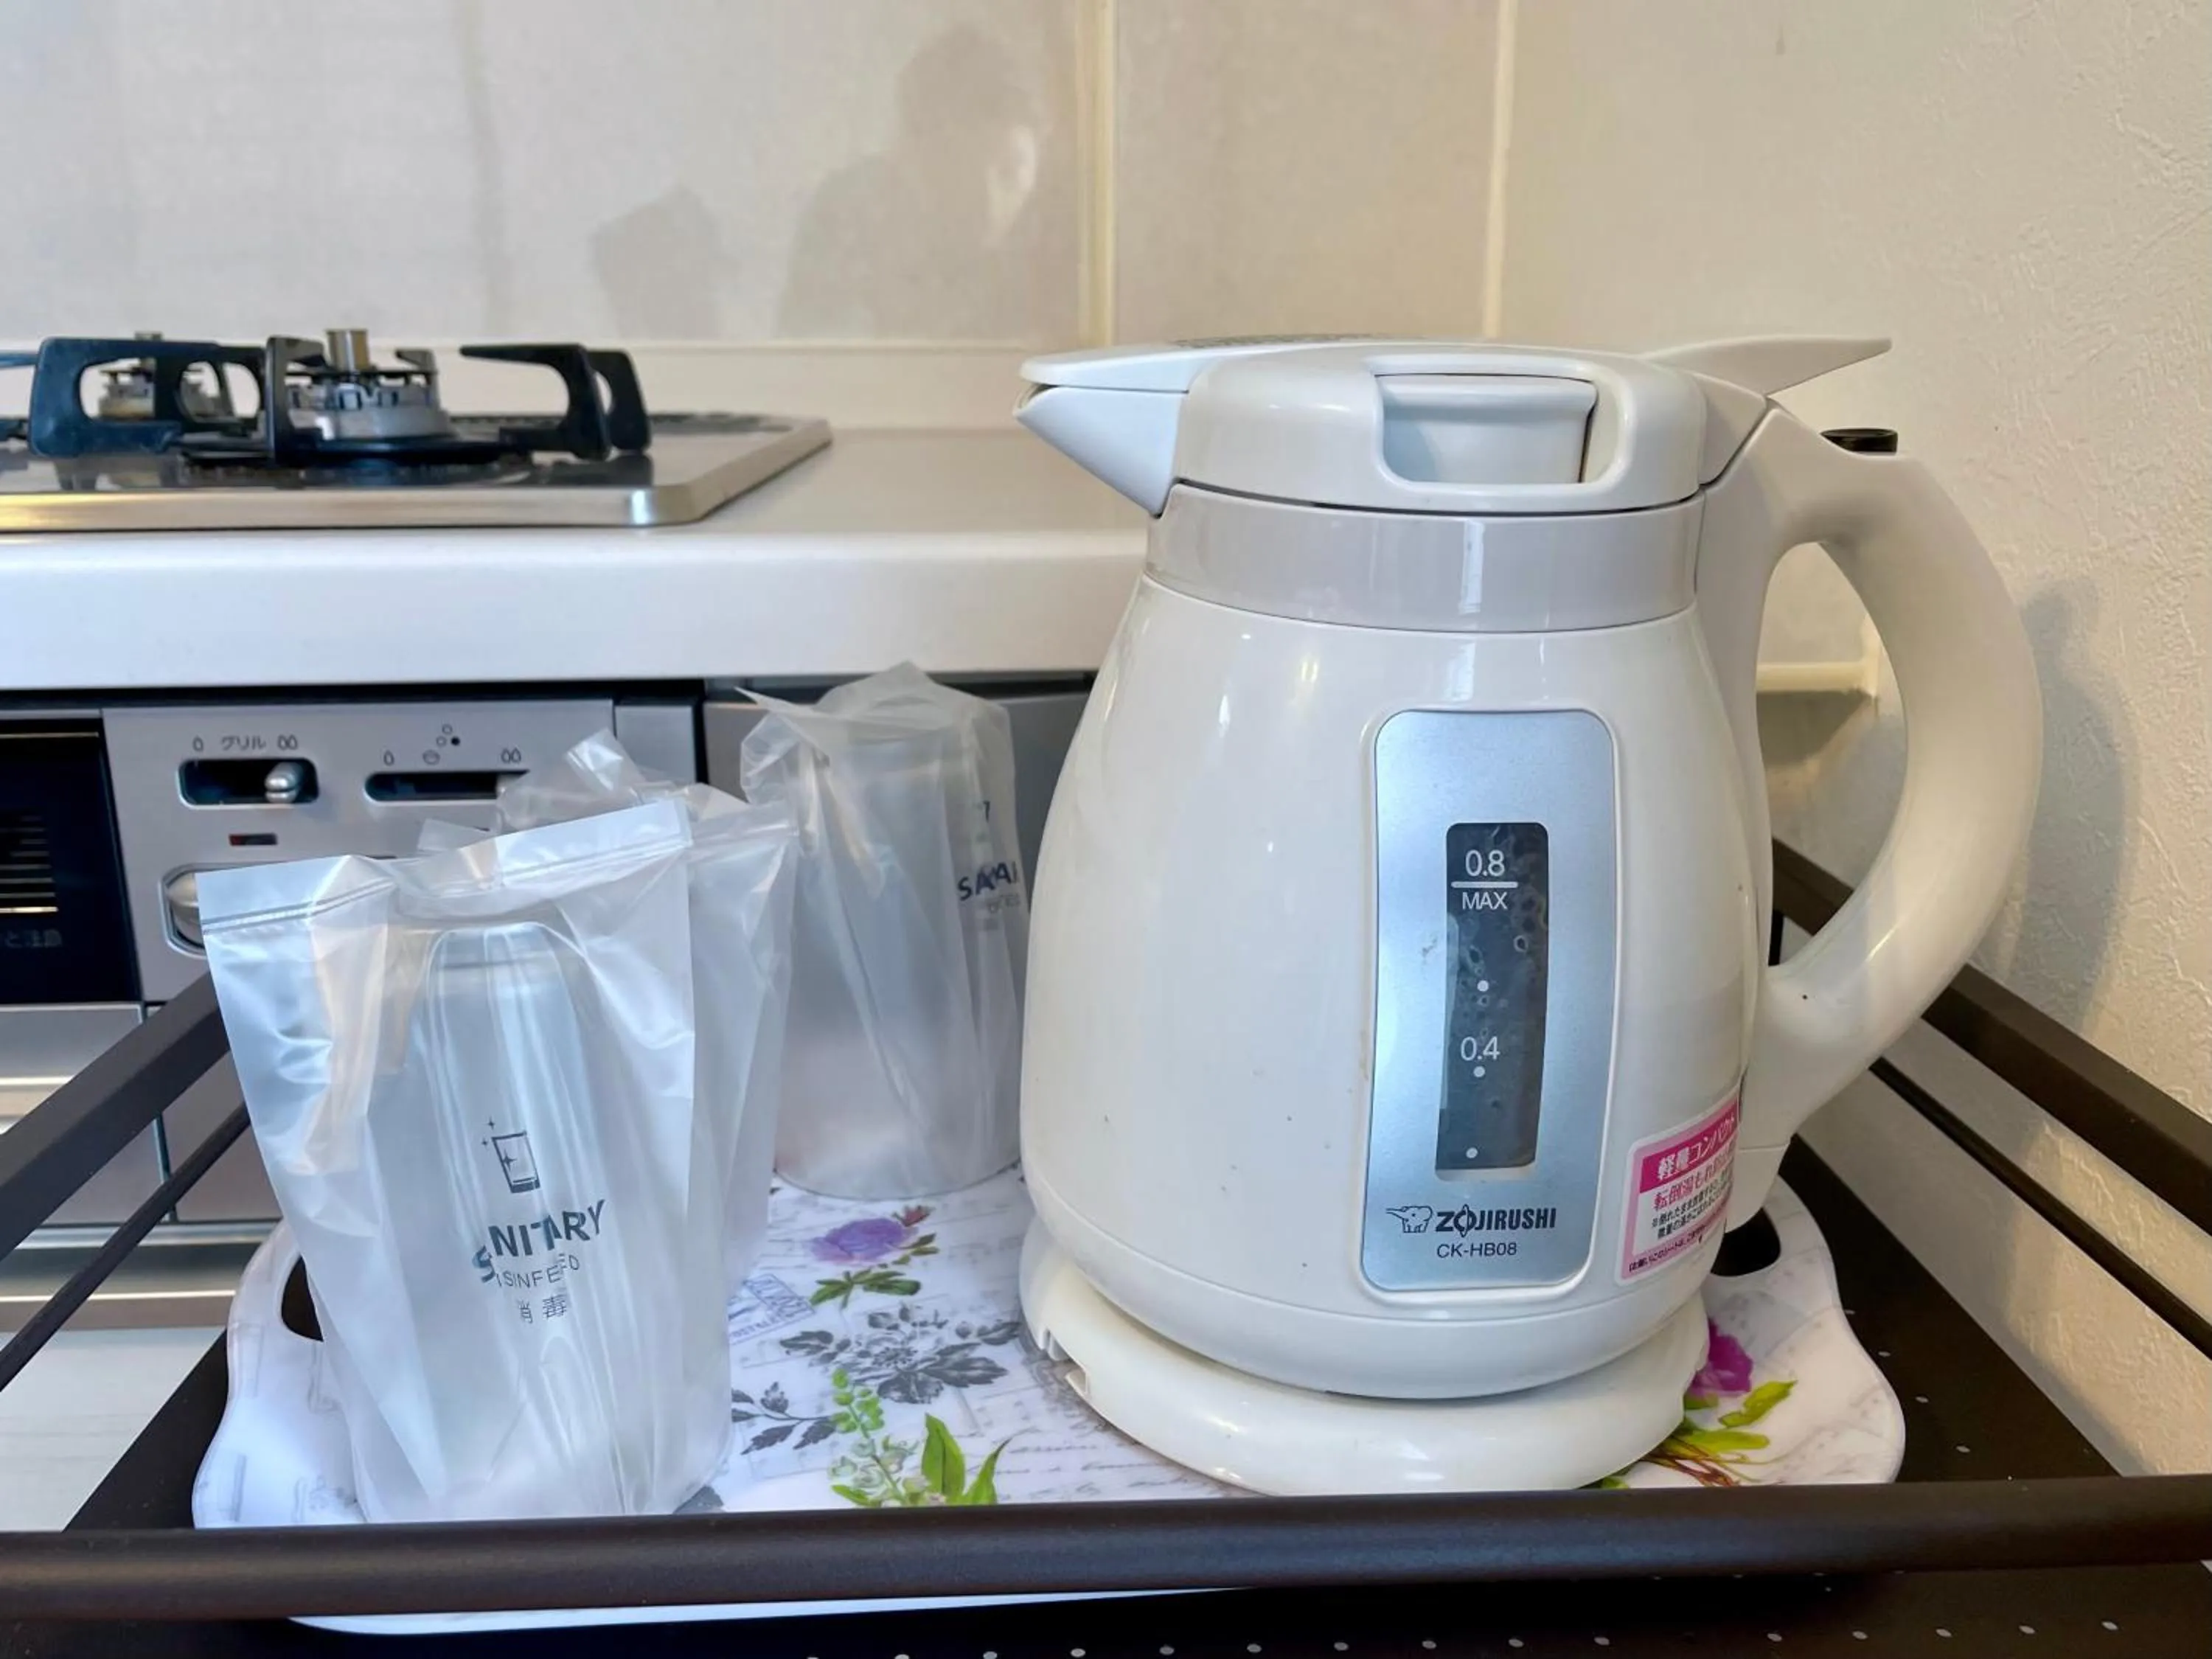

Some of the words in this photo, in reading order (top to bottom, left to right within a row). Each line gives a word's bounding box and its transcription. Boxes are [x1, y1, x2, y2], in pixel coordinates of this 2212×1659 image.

[1465, 849, 1506, 877] 0.8
[1462, 891, 1509, 911] MAX
[1461, 1036, 1500, 1061] 0.4
[1436, 1203, 1557, 1237] ZOJIRUSHI
[1437, 1242, 1517, 1258] CK-HB08
